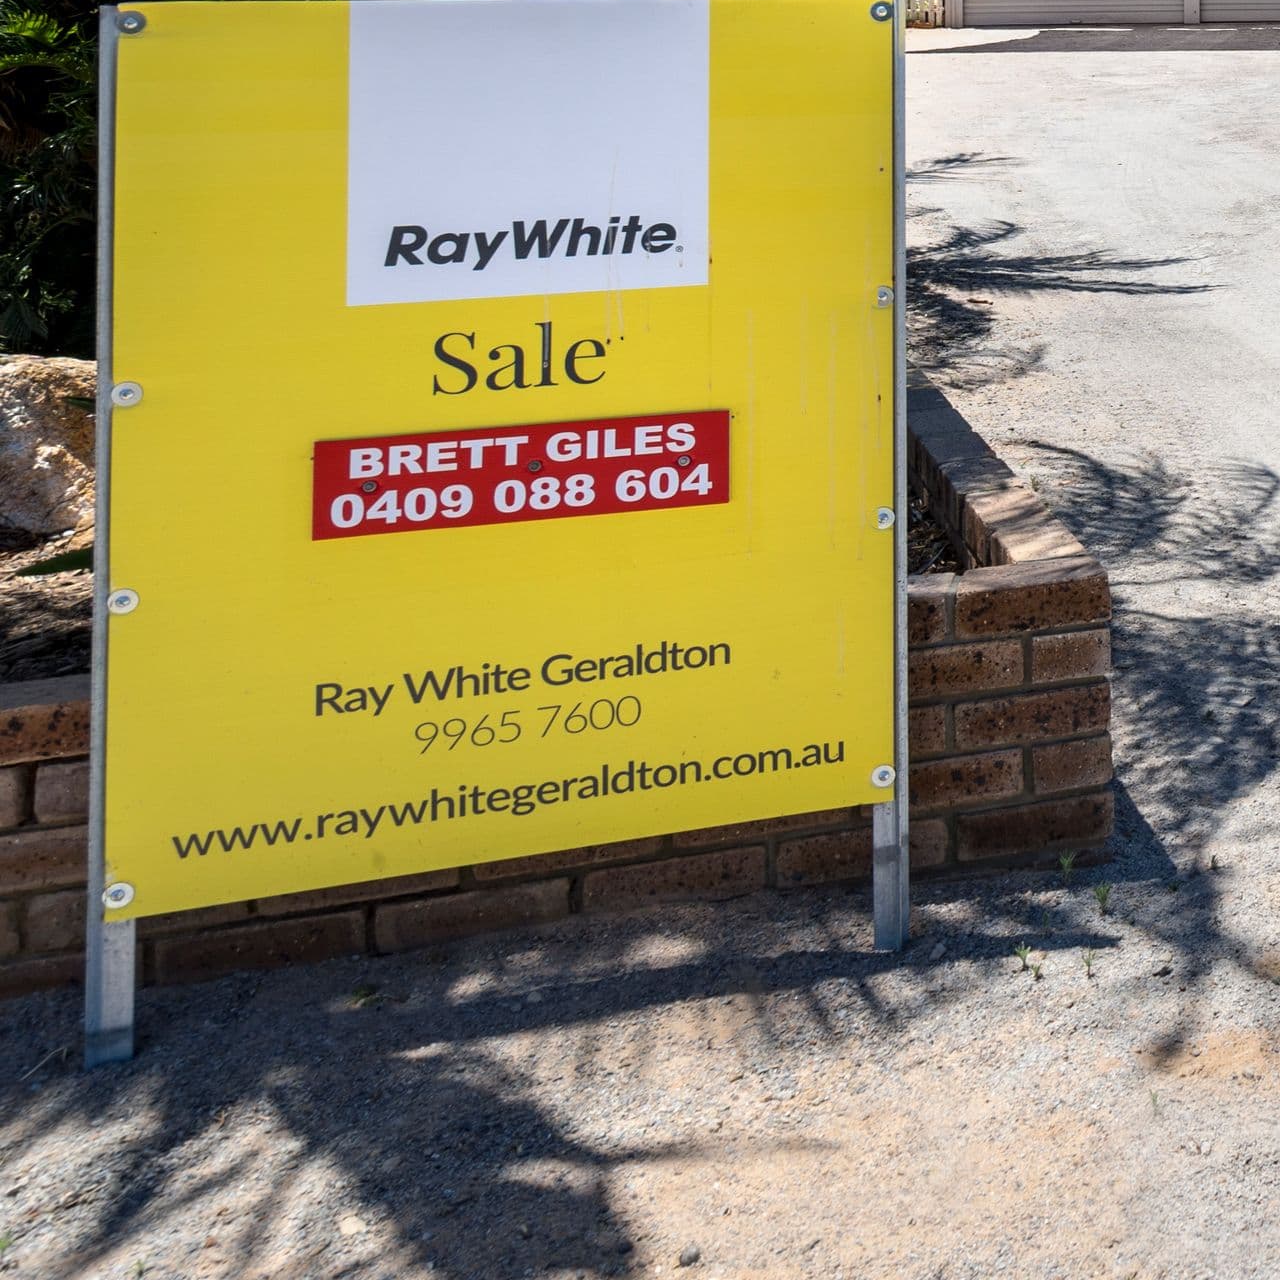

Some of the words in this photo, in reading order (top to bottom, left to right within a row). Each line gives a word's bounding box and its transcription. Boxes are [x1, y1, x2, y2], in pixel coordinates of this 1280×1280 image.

[432, 321, 608, 396] Sale
[348, 435, 529, 479] BRETT
[545, 423, 696, 462] GILES
[330, 484, 473, 528] 0409
[493, 474, 596, 513] 088
[615, 463, 713, 503] 604
[315, 683, 394, 716] Ray
[403, 663, 530, 703] White
[541, 641, 731, 686] Geraldton
[414, 710, 521, 754] 9965
[537, 695, 641, 737] 7600
[171, 741, 845, 858] www.raywhitegeraldton.com.au
